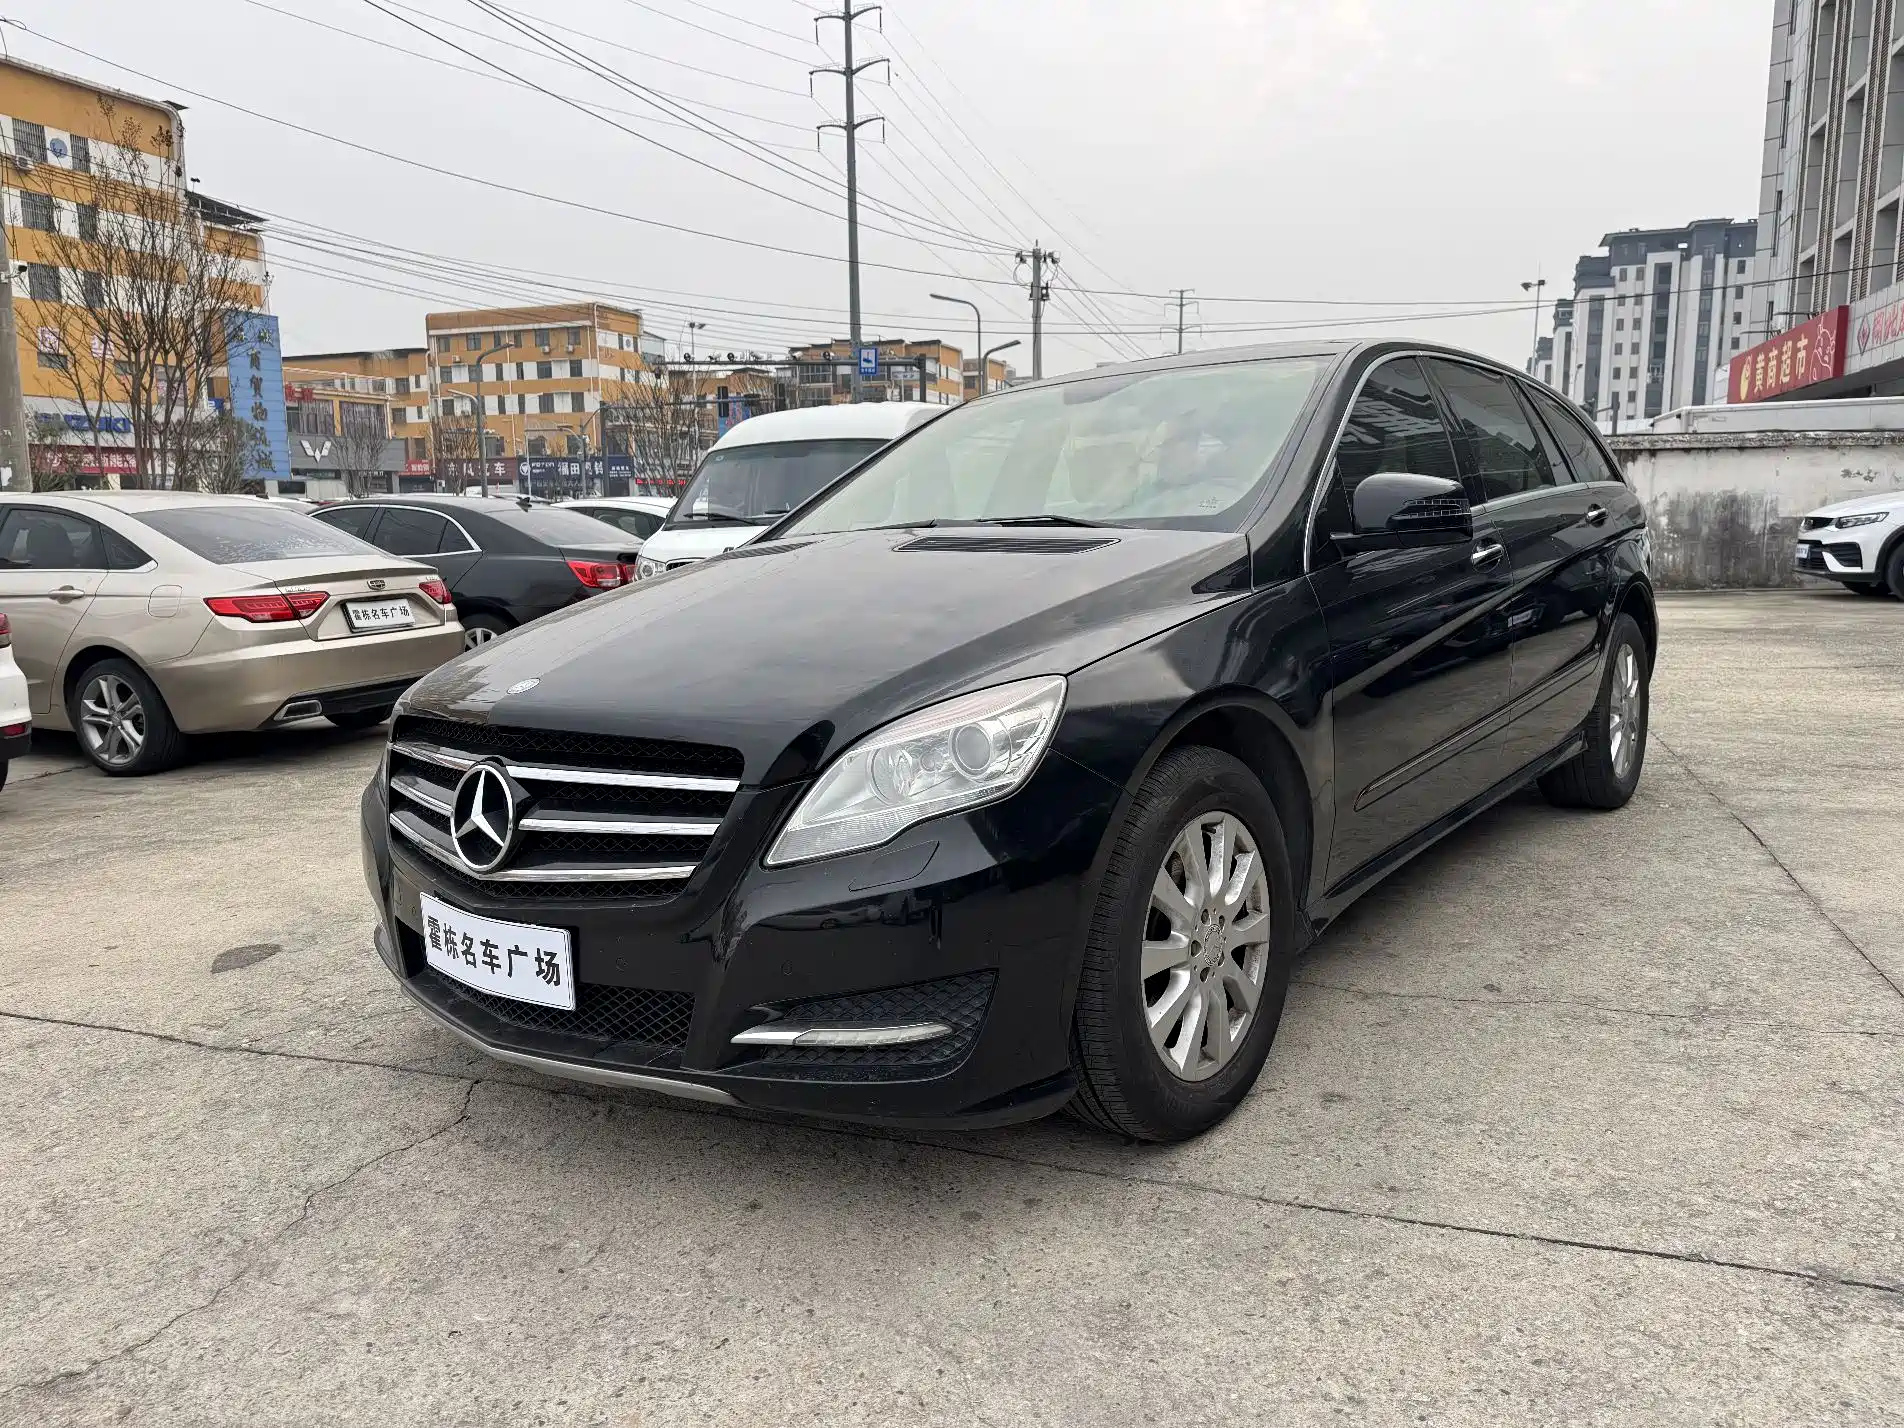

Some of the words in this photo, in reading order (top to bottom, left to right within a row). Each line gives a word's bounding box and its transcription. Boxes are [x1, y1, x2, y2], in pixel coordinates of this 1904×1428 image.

[1872, 301, 1904, 345] 湖北
[1754, 332, 1809, 394] 黄商超市
[352, 606, 410, 621] 霍栋名车广场
[427, 915, 561, 987] 霍栋名车广场
